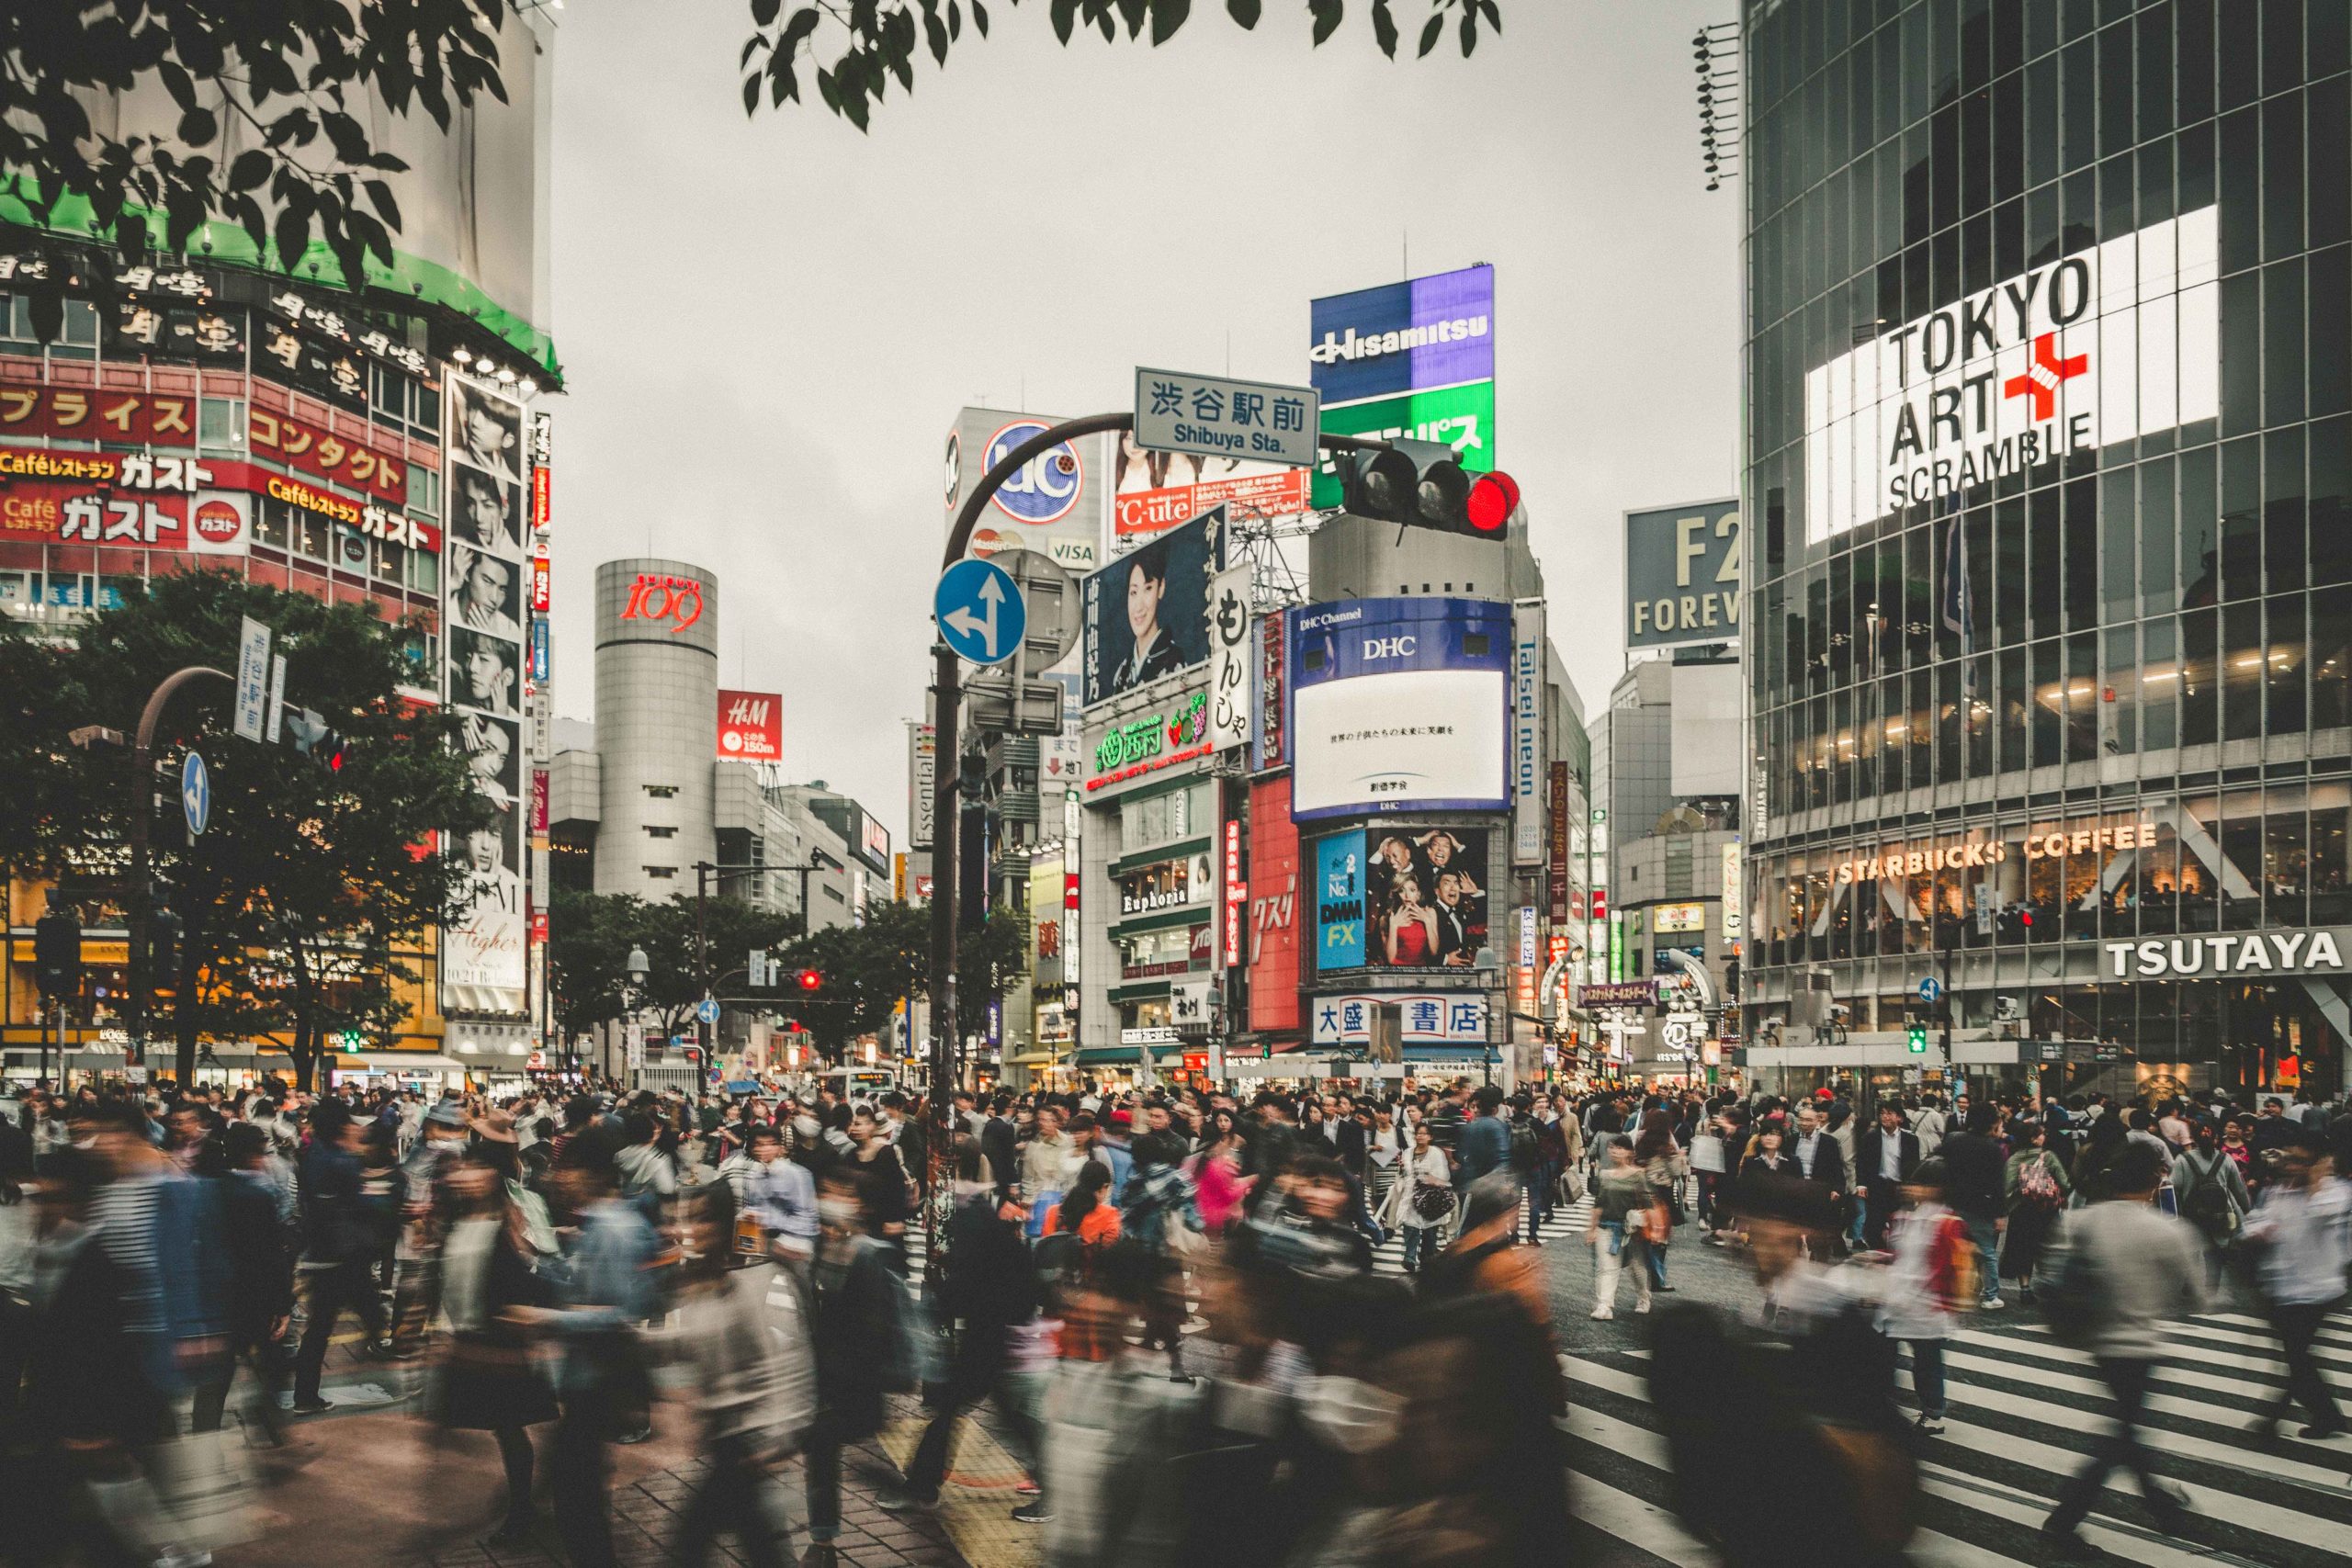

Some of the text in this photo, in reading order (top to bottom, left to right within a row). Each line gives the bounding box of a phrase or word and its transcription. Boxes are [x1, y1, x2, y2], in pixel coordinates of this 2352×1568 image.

[1890, 258, 2090, 389] TOKYO
[0, 389, 190, 434] プライス
[1150, 381, 1305, 433] 渋谷駅前
[1890, 371, 1995, 466] ART
[250, 410, 401, 489] コンタクト
[1174, 423, 1285, 454] Shibuya Sta.
[120, 453, 213, 492] ガスト
[1890, 412, 2091, 512] SCRAMBLE
[5, 496, 56, 517] Café
[62, 495, 179, 543] ガスト
[5, 518, 56, 532] レストラン
[199, 518, 238, 533] ガスト
[361, 505, 429, 550] ガスト
[1055, 544, 1093, 560] VISA
[637, 572, 701, 591] SHIBUYA
[619, 583, 703, 633] 109
[1299, 608, 1362, 632] DHC Channel
[1634, 591, 1739, 635] FOREV
[1216, 588, 1246, 739] もんじゃ
[1363, 636, 1416, 660] DHC
[728, 697, 770, 728] H&M
[1519, 636, 1536, 795] Taisei neon
[743, 741, 775, 754] 150m
[916, 756, 934, 844] Essential
[1370, 781, 1407, 792] 創価学会
[1380, 801, 1399, 810] DHC
[2024, 823, 2157, 860] COFFEE
[1838, 840, 2006, 885] STARBUCKS
[1124, 888, 1186, 912] Euphoria
[1320, 899, 1363, 925] DMM
[1192, 927, 1211, 953] JTB
[1327, 922, 1355, 947] FX
[2105, 931, 2344, 976] TSUTAYA
[1320, 1002, 1478, 1032] 大盛書店
